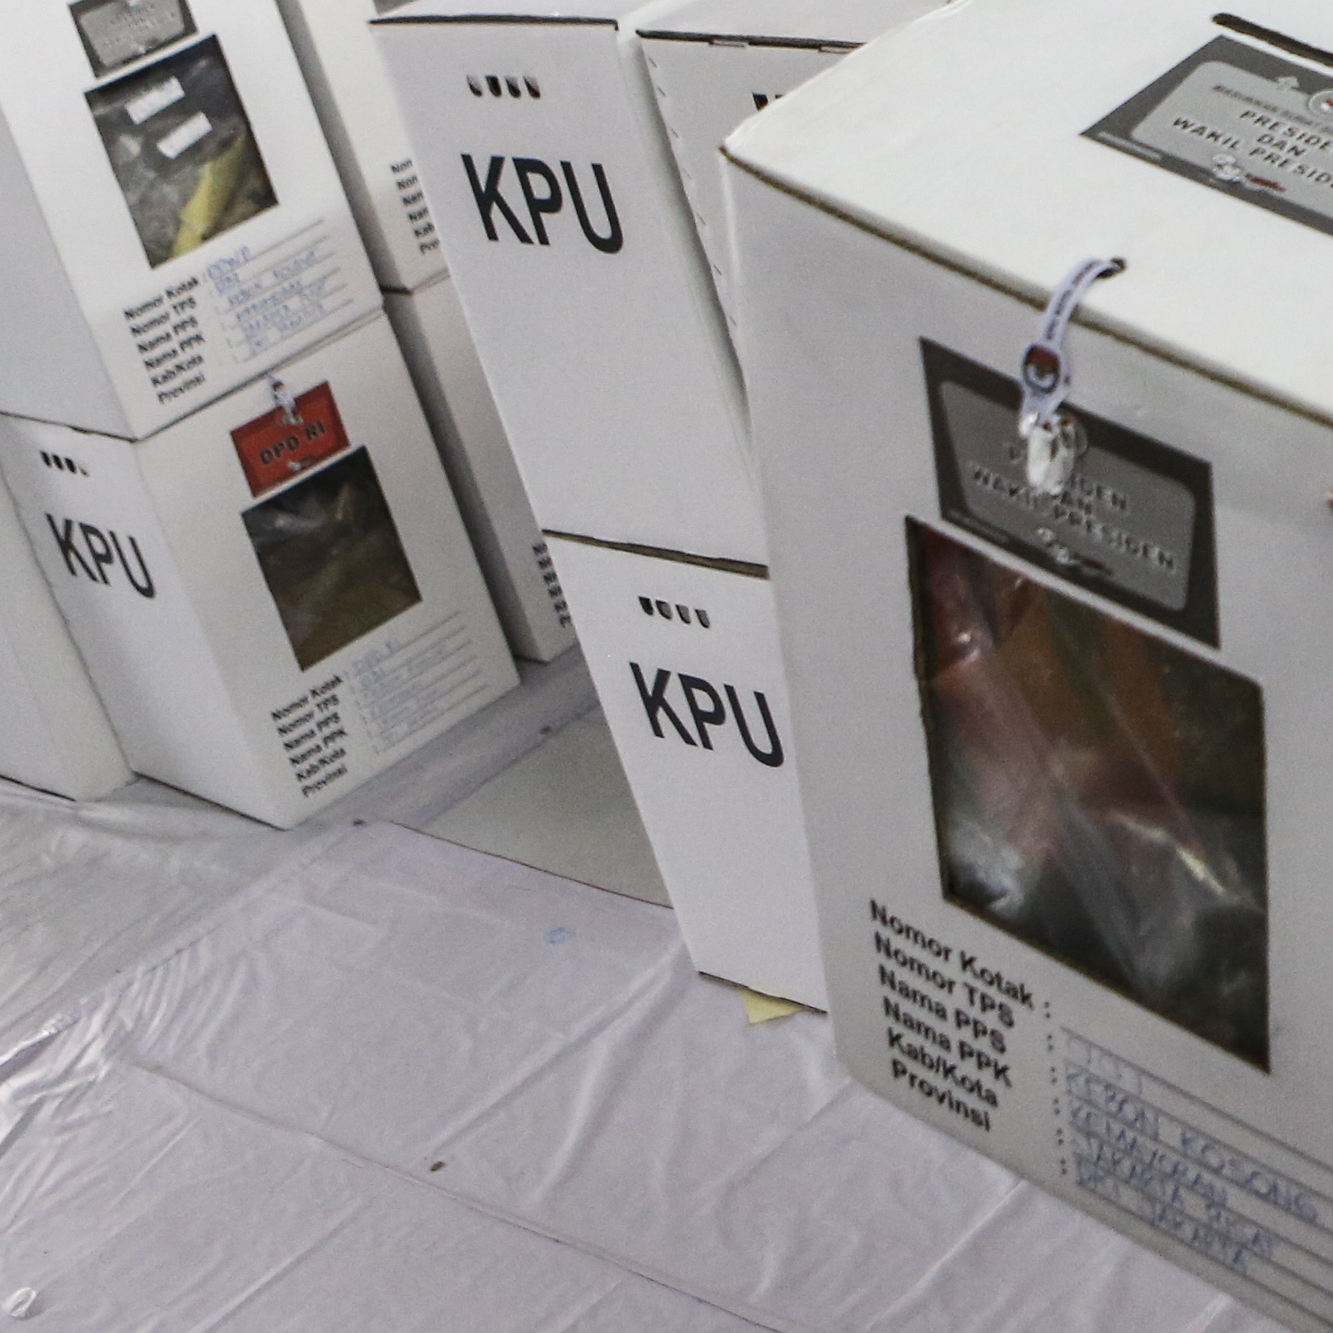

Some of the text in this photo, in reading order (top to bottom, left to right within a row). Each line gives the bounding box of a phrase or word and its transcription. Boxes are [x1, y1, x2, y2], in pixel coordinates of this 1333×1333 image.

[1173, 116, 1243, 151] WAKIL
[1256, 133, 1308, 158] DAN
[460, 153, 624, 254] KPU
[259, 419, 326, 466] DPD RI
[45, 512, 156, 599] KPU
[629, 661, 785, 768] KPU
[870, 898, 1036, 1011] Nomor Kotak
[874, 930, 1015, 1028] Nomor TPS
[879, 963, 948, 1022] Nama
[954, 1007, 1007, 1055] PPS
[883, 995, 952, 1052] Nama
[958, 1039, 1013, 1090] PPK
[888, 1026, 999, 1108] Kab/Kota
[891, 1057, 991, 1133] Provinsi
